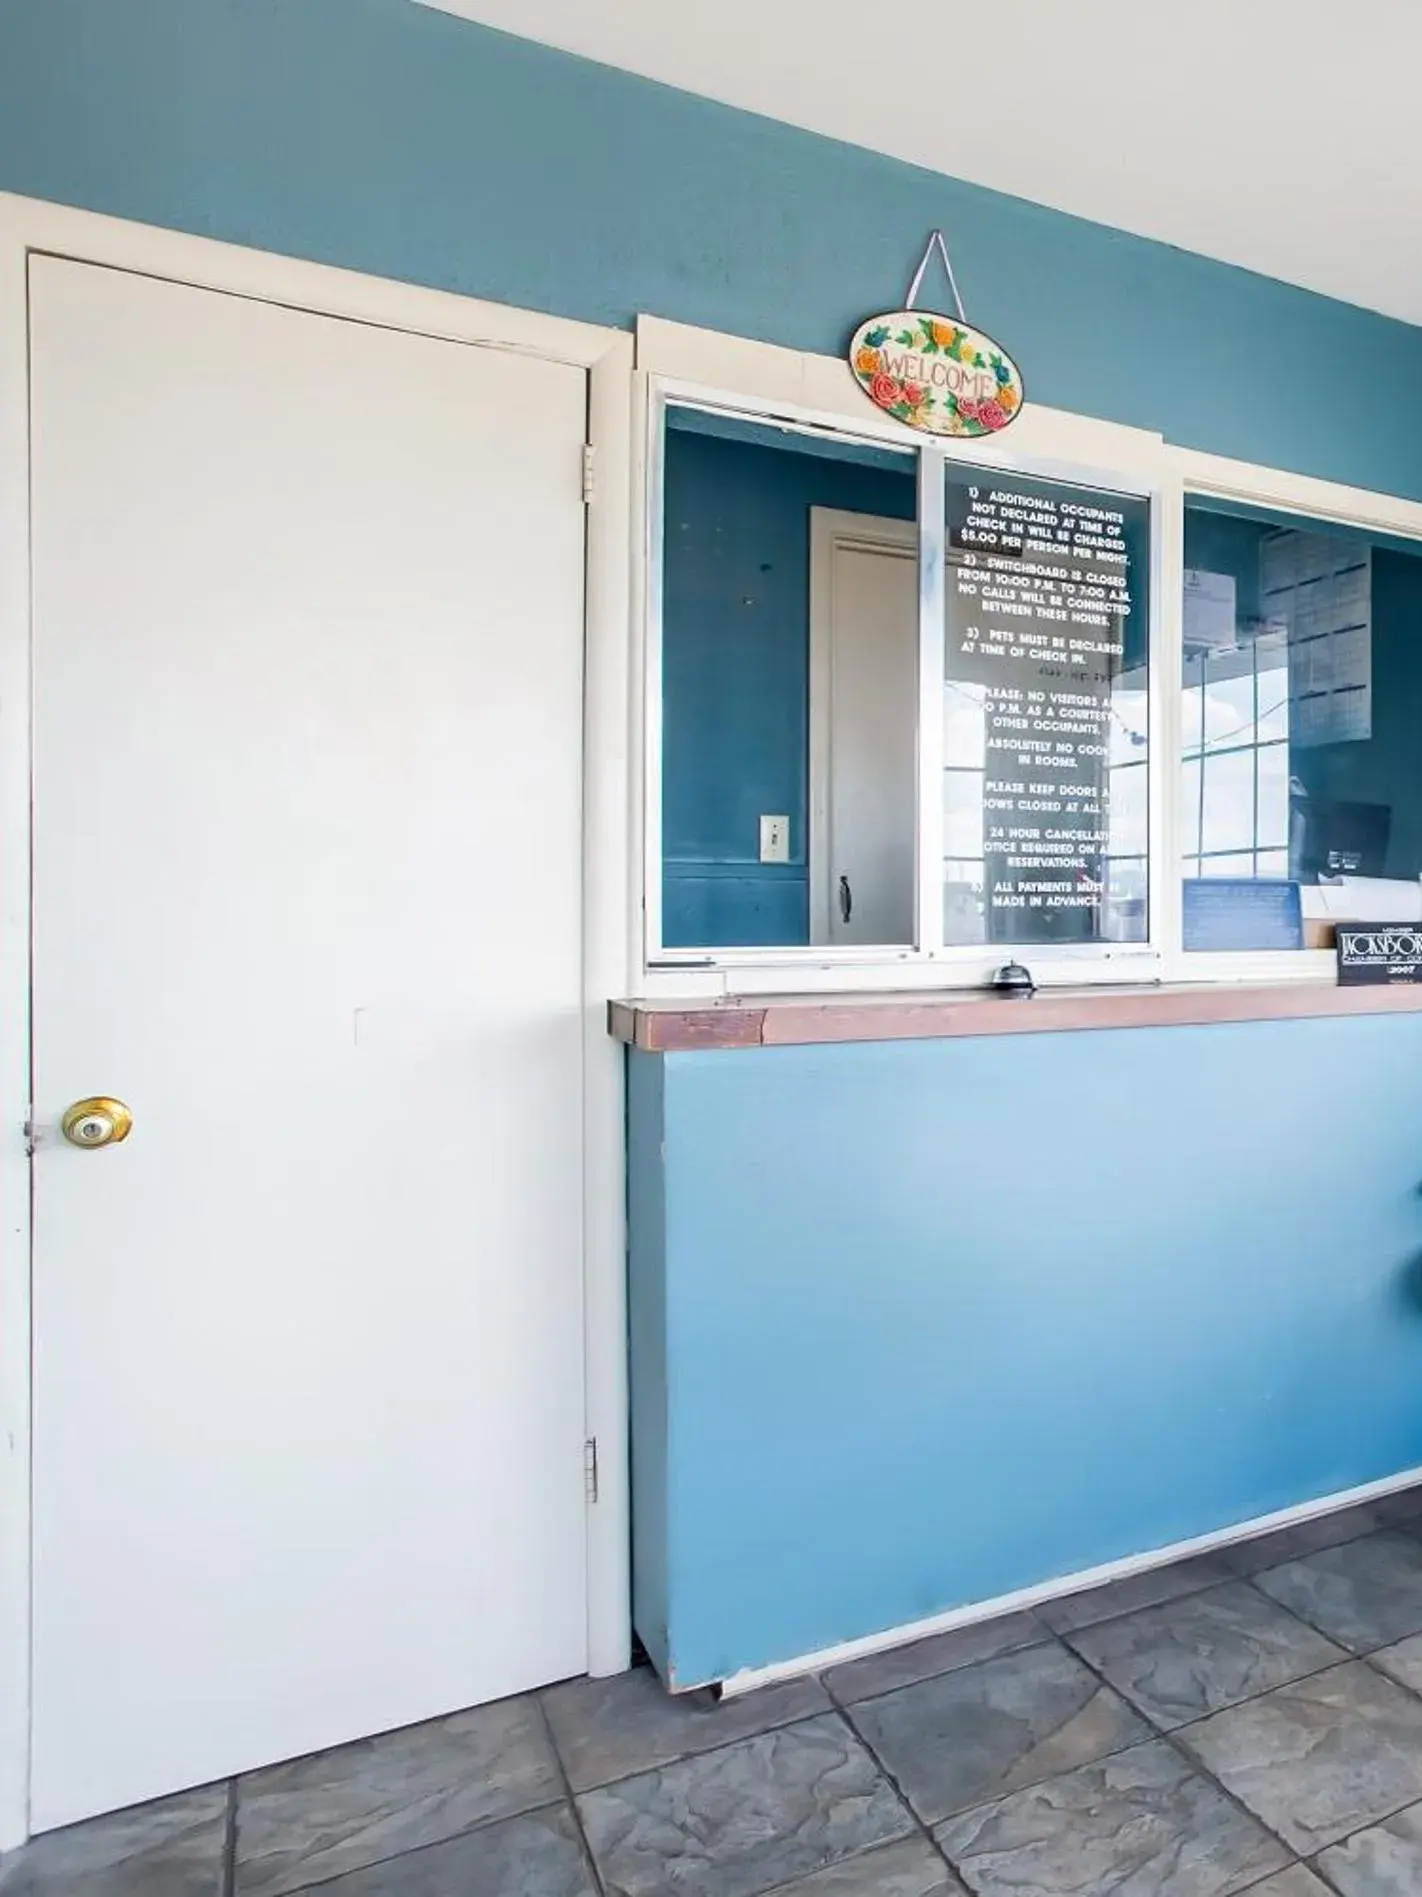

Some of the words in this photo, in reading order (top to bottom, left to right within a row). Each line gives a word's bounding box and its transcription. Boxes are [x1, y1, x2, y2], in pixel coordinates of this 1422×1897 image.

[881, 350, 992, 399] WELCOME
[989, 491, 1056, 511] ADDITIONAL
[1060, 504, 1124, 523] OCCUPANTS
[972, 502, 995, 514] NOT
[1001, 508, 1058, 525] DECLARED
[1062, 518, 1075, 528] AT
[1080, 521, 1102, 534] TIME
[1107, 526, 1121, 536] OF
[966, 515, 1006, 531] CHECK
[1012, 523, 1023, 534] IN
[1028, 525, 1052, 538] WILL
[1057, 530, 1070, 541] BE
[1074, 532, 1125, 550] CHARGED
[961, 528, 997, 543] $5.00
[1002, 536, 1021, 548] PER
[1027, 539, 1069, 554] PERSON
[1073, 546, 1092, 558] PER
[964, 554, 976, 566] 2)
[987, 557, 1067, 578] SWITCHBOARD
[1071, 571, 1082, 581] IS
[1086, 573, 1126, 587] CLOSED
[958, 568, 991, 583] FROM
[996, 574, 1030, 588] 10:00
[1061, 583, 1074, 593] TO
[1080, 586, 1105, 598] 7:00
[958, 583, 976, 594] NO
[982, 586, 1015, 600] CALLS
[1021, 592, 1045, 604] WILL
[1051, 596, 1063, 606] BE
[1068, 597, 1131, 615] CONNECTED
[982, 601, 1032, 617] BETWEEN
[1036, 607, 1067, 621] THESE
[1072, 613, 1110, 626] HOURS.
[966, 627, 979, 640] 3)
[990, 630, 1014, 642] PETS
[1019, 633, 1047, 646] MUST
[1052, 637, 1064, 647] BE
[1069, 639, 1124, 655] DECLARED
[961, 642, 975, 653] AT
[979, 645, 1005, 656] TIME
[1010, 648, 1025, 657] OF
[1029, 649, 1068, 662] CHECK
[1028, 692, 1045, 702] NO
[1050, 692, 1097, 706] VISITORS
[1027, 705, 1041, 716] AS
[1047, 707, 1053, 716] A
[993, 717, 1028, 729] OTHER
[988, 737, 1052, 752] ABSOLUTELY
[1057, 743, 1073, 753] NO
[1018, 755, 1030, 765] IN
[986, 781, 1025, 793] PLEASE
[1029, 783, 1055, 794] KEEP
[1060, 786, 1097, 797] DOORS
[1018, 799, 1060, 812] CLOSED
[1065, 802, 1078, 812] AT
[1083, 802, 1101, 813] ALL
[991, 828, 1004, 838] 24
[1009, 828, 1039, 839] HOUR
[984, 842, 1015, 853] OTICE
[1022, 843, 1074, 854] REQUIRED
[1078, 845, 1094, 854] ON
[995, 882, 1014, 892] ALL
[1018, 881, 1072, 892] PAYMENTS
[1077, 881, 1105, 893] MUST
[992, 896, 1025, 908] MADE
[1030, 896, 1042, 906] IN
